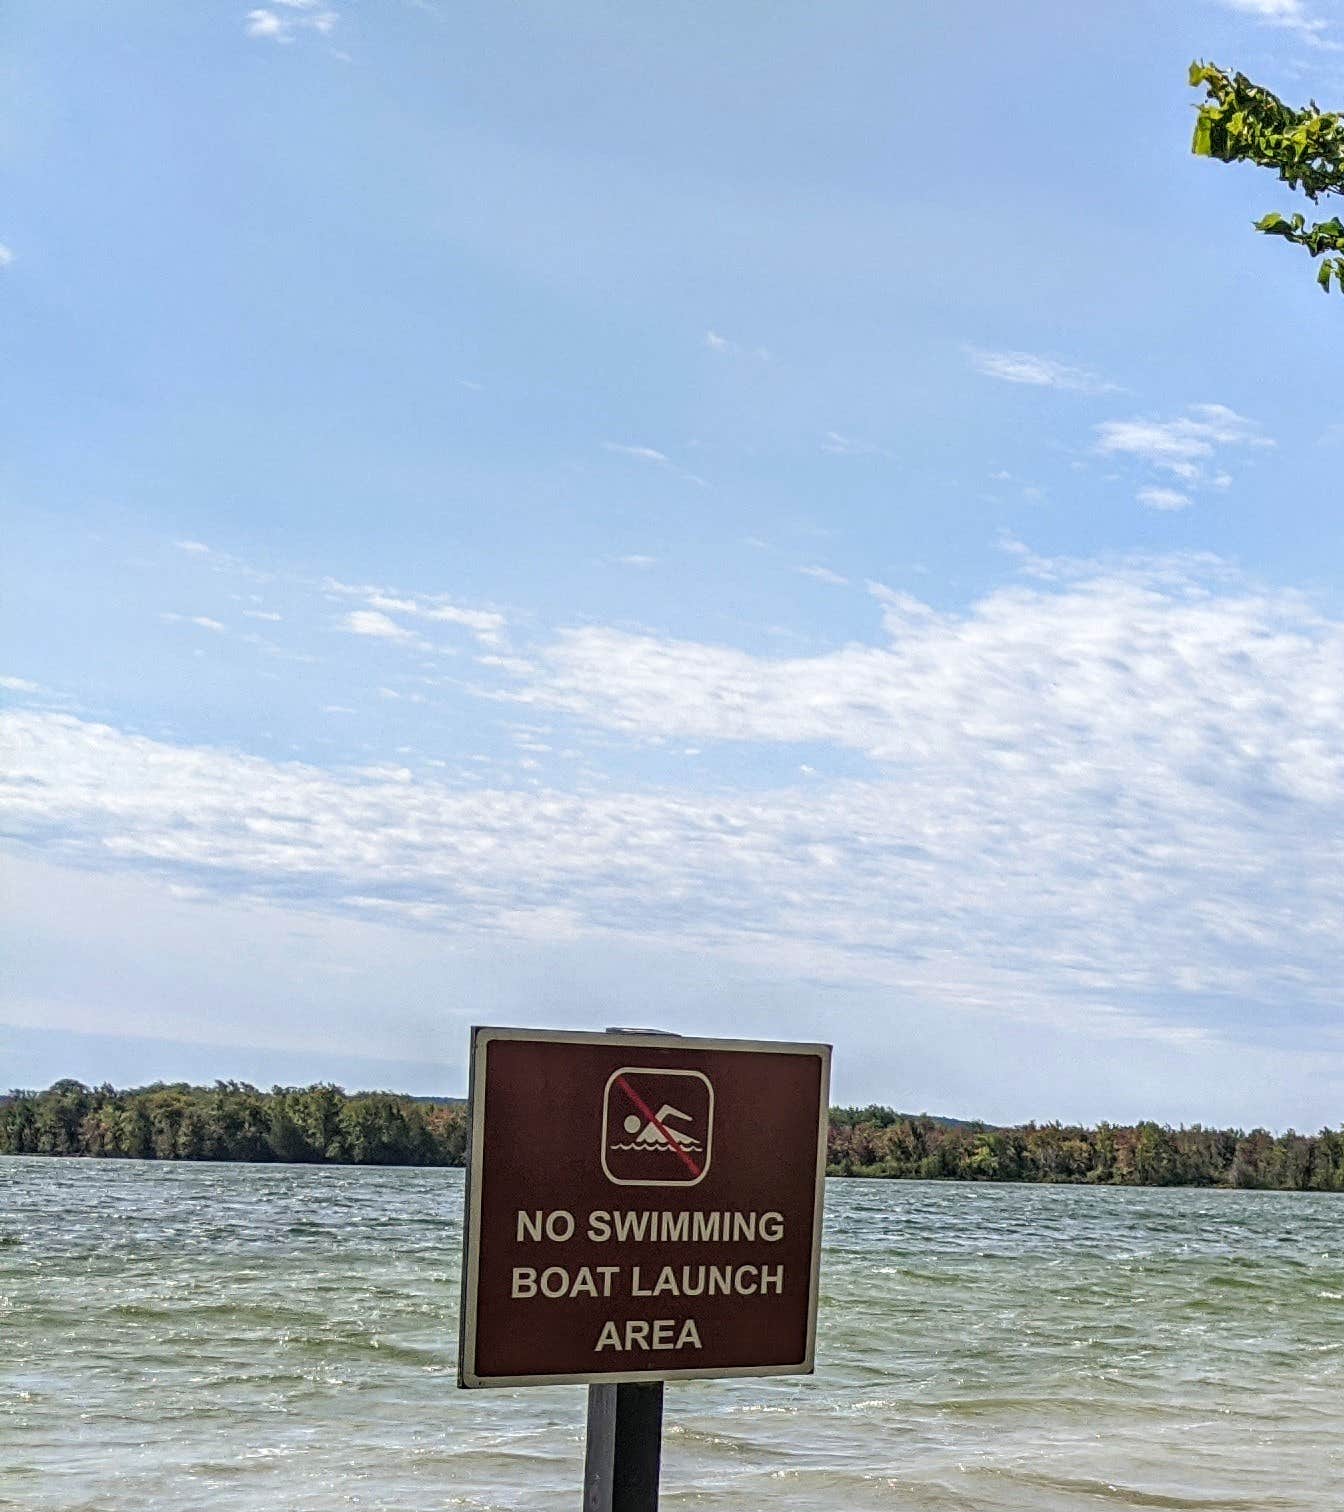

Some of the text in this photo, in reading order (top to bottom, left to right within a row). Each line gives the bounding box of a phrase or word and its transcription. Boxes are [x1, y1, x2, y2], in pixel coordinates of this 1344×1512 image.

[516, 1211, 785, 1242] NO SWIMMING
[511, 1265, 783, 1298] BOAT LAUNCH
[594, 1319, 702, 1351] AREA
